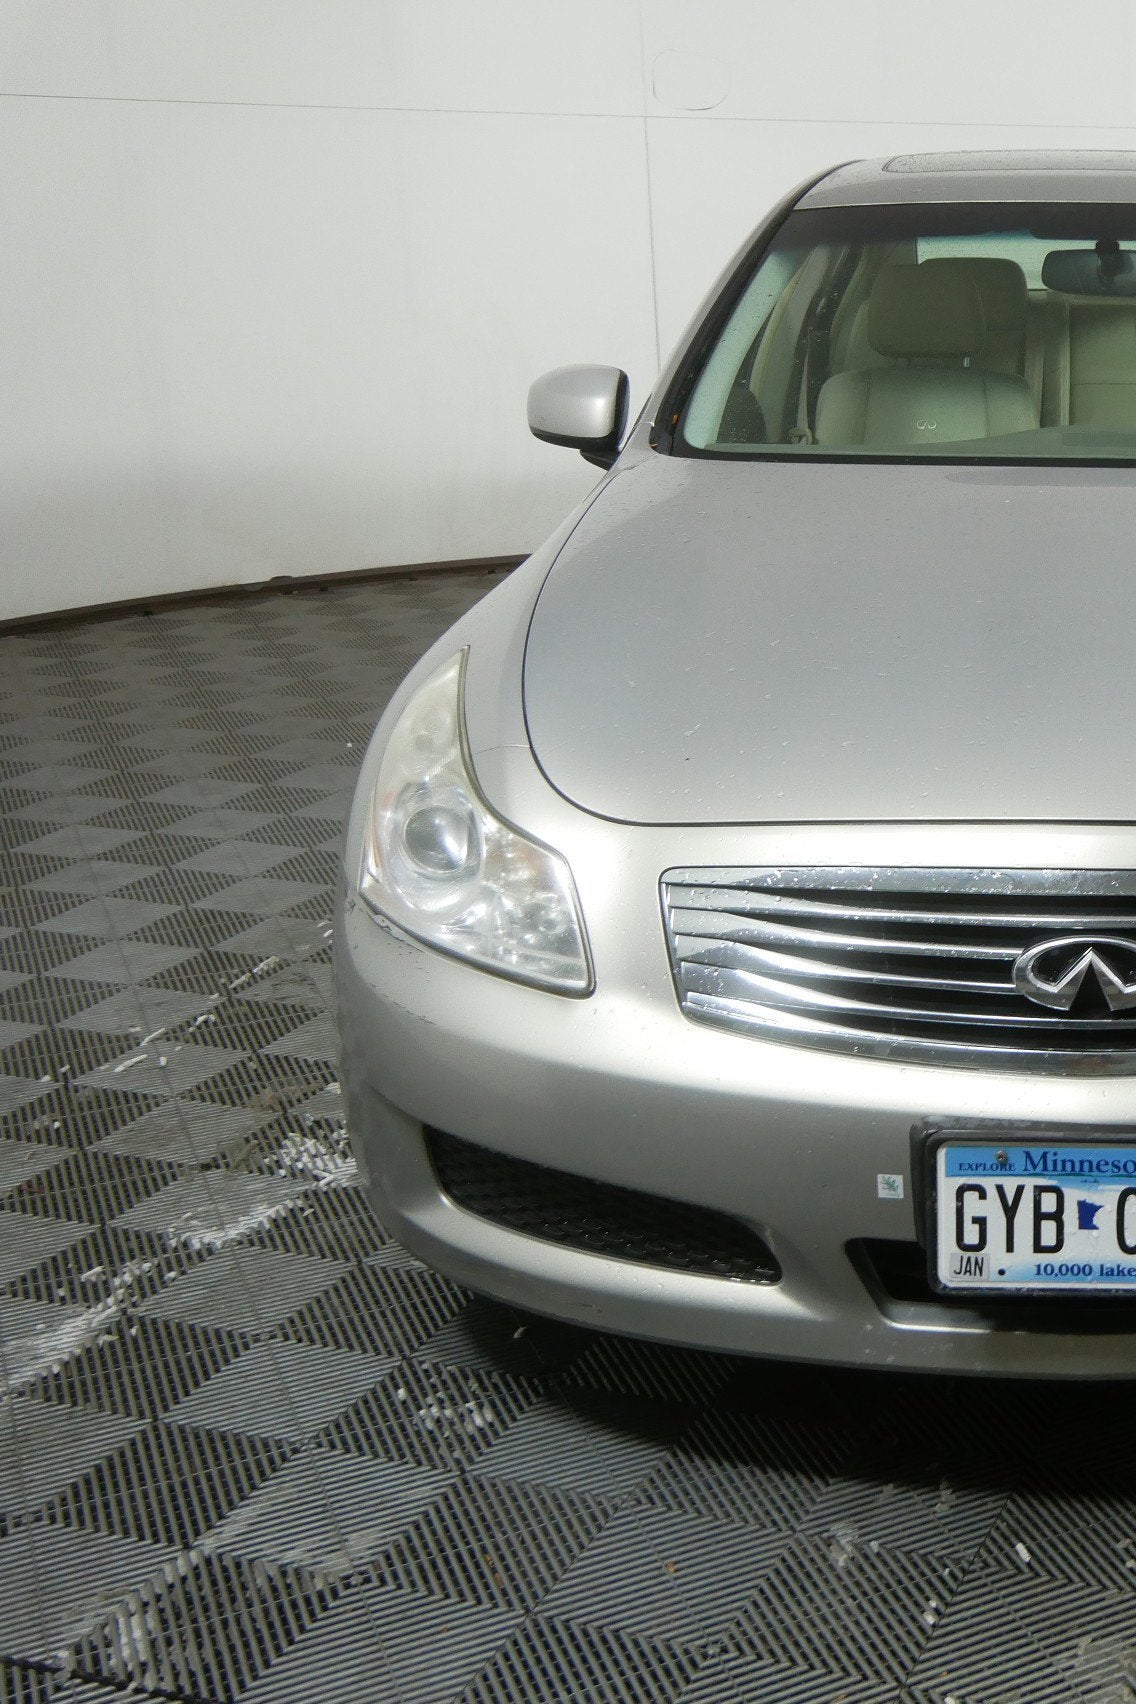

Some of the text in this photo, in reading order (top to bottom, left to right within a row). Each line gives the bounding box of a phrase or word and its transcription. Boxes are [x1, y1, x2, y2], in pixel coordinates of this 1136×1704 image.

[955, 1183, 1065, 1254] GYB
[953, 1255, 984, 1277] JAN
[1034, 1263, 1093, 1277] 10,000
